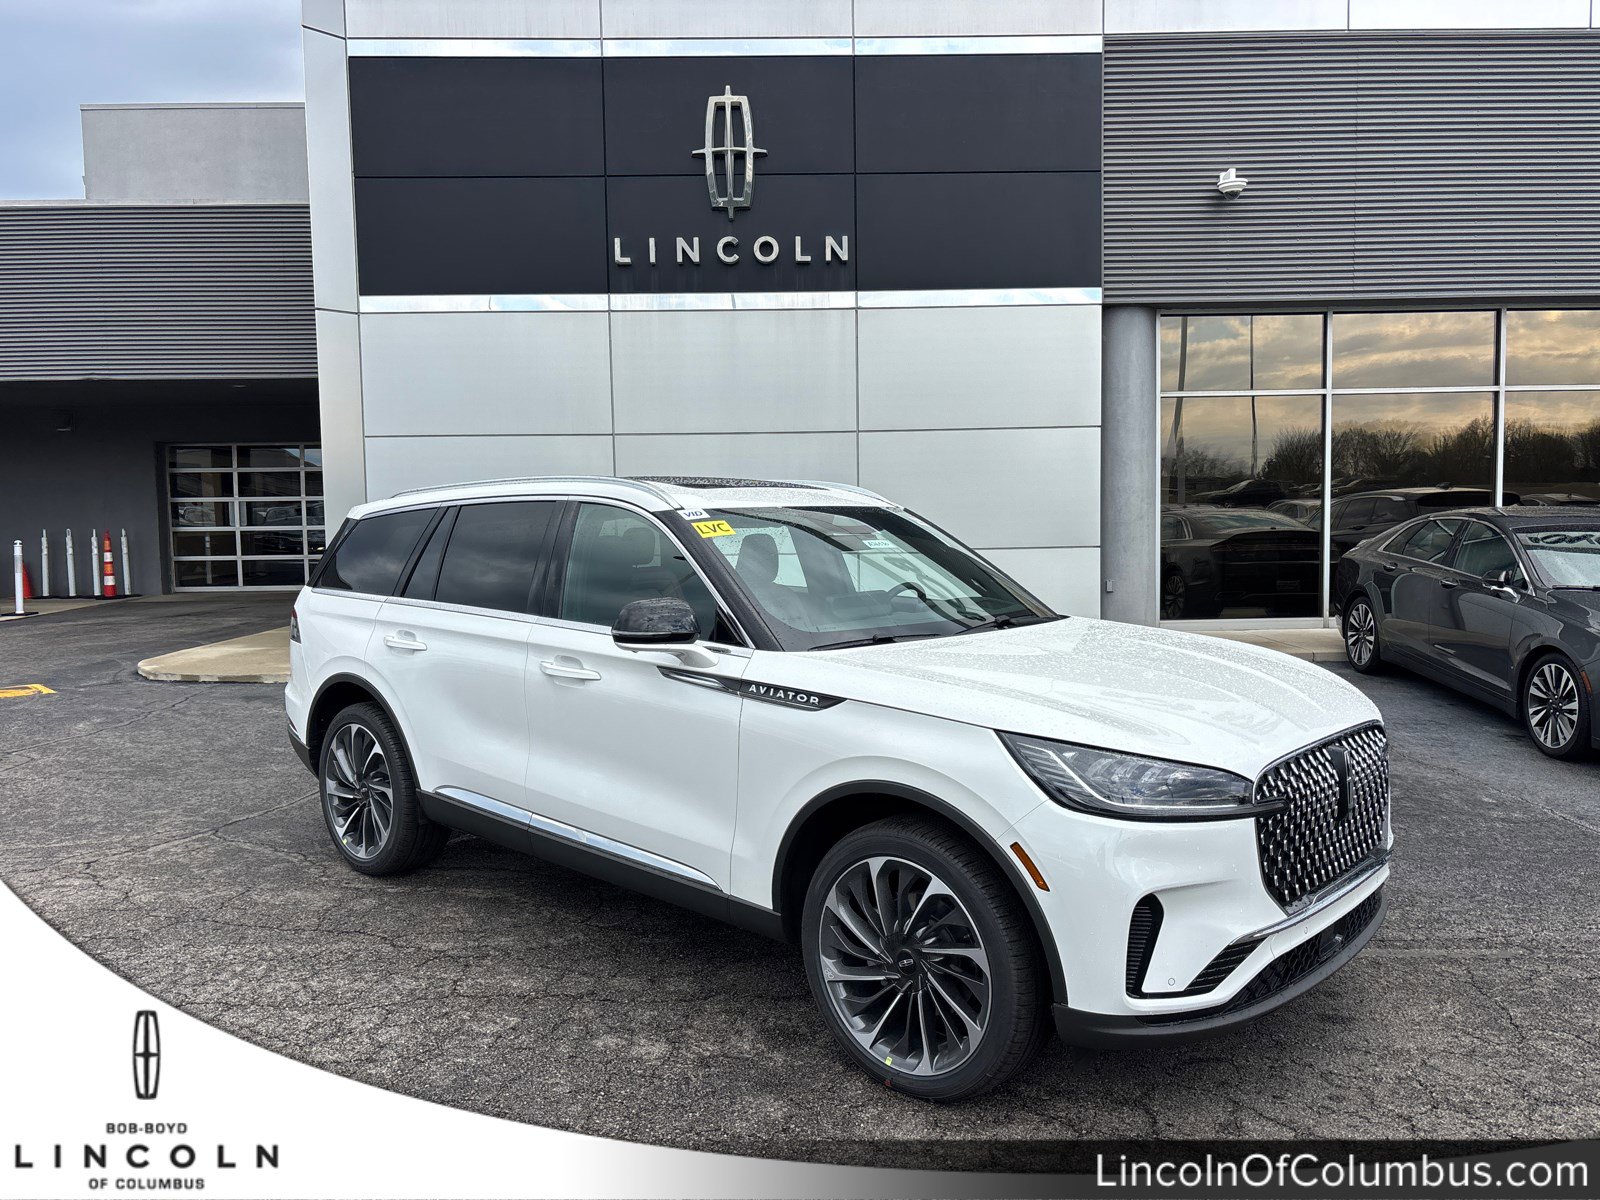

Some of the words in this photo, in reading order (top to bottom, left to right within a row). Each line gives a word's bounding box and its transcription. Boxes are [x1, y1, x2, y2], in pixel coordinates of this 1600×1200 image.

[614, 235, 849, 265] LINCOLN
[696, 522, 731, 535] LVC
[748, 684, 819, 705] AVIATOR
